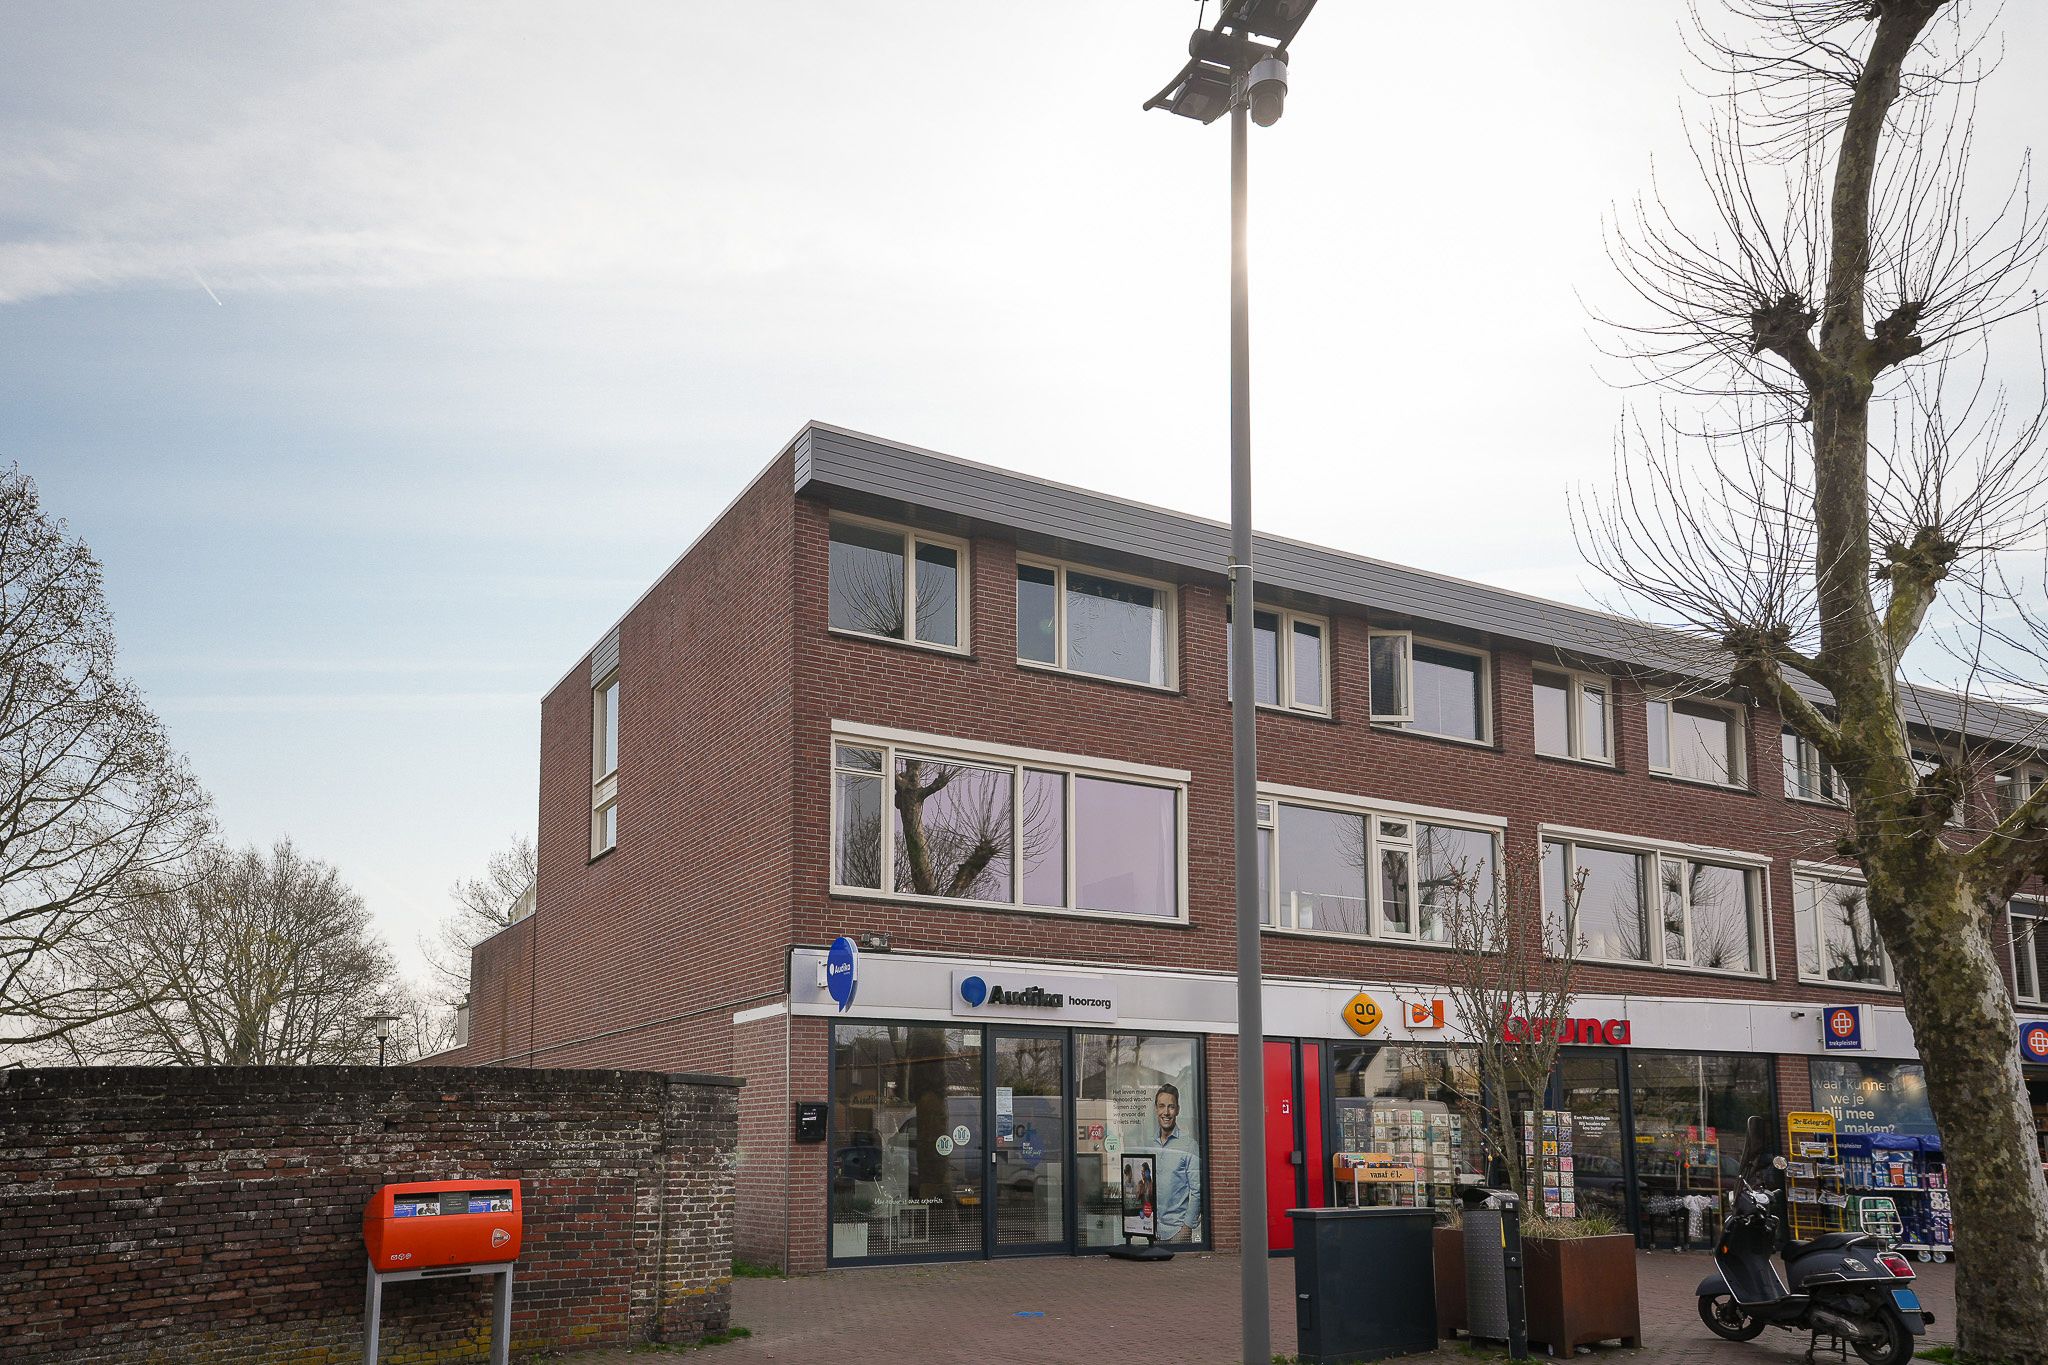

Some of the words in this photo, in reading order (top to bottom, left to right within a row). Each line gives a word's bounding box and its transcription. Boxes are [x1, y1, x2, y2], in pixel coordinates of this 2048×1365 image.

[834, 963, 850, 974] Audika
[988, 985, 1064, 1008] Audika
[1068, 995, 1112, 1009] hoorzorg
[1812, 1079, 1842, 1090] waar
[1846, 1079, 1895, 1092] kunnen
[1830, 1094, 1850, 1104] we
[1852, 1093, 1865, 1107] je
[1846, 1109, 1875, 1120] mee
[1844, 1122, 1895, 1134] maken?
